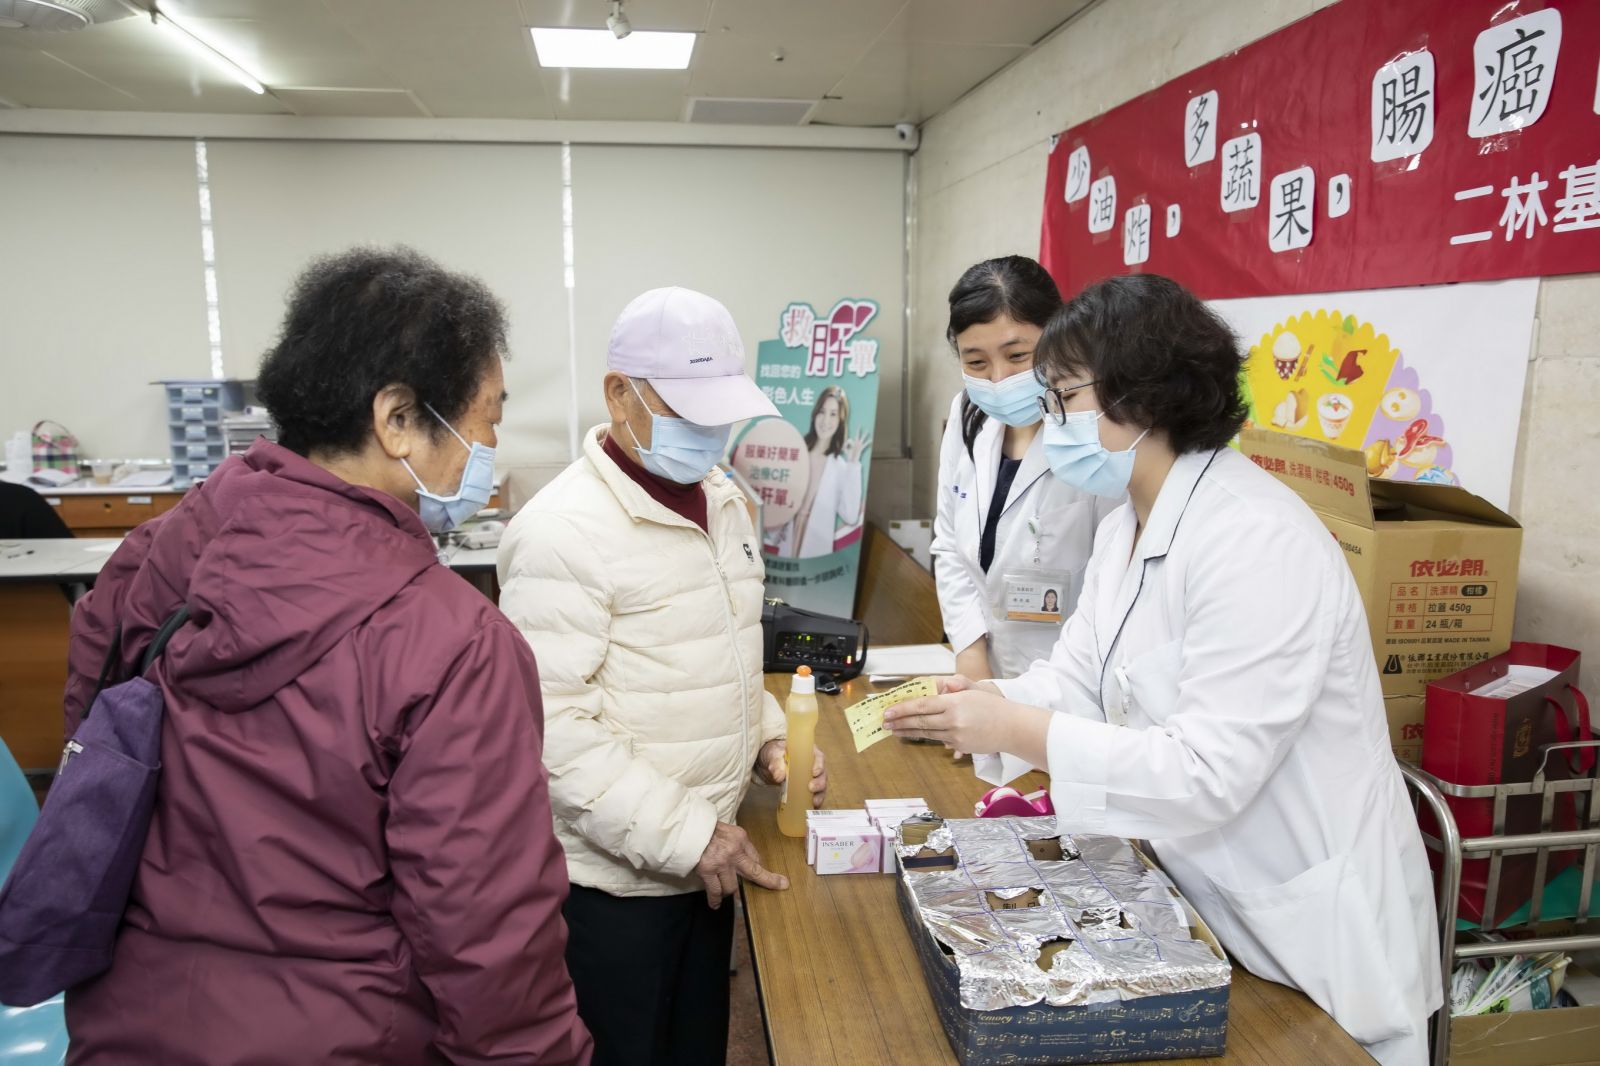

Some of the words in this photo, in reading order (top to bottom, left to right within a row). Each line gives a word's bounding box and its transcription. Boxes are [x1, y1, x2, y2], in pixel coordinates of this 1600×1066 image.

[1450, 160, 1600, 246] 二林基
[1333, 475, 1356, 497] 450g
[1408, 558, 1485, 577] 依必朗
[1449, 603, 1472, 614] 450g
[1425, 620, 1437, 629] 24
[978, 1013, 1013, 1024] emory
